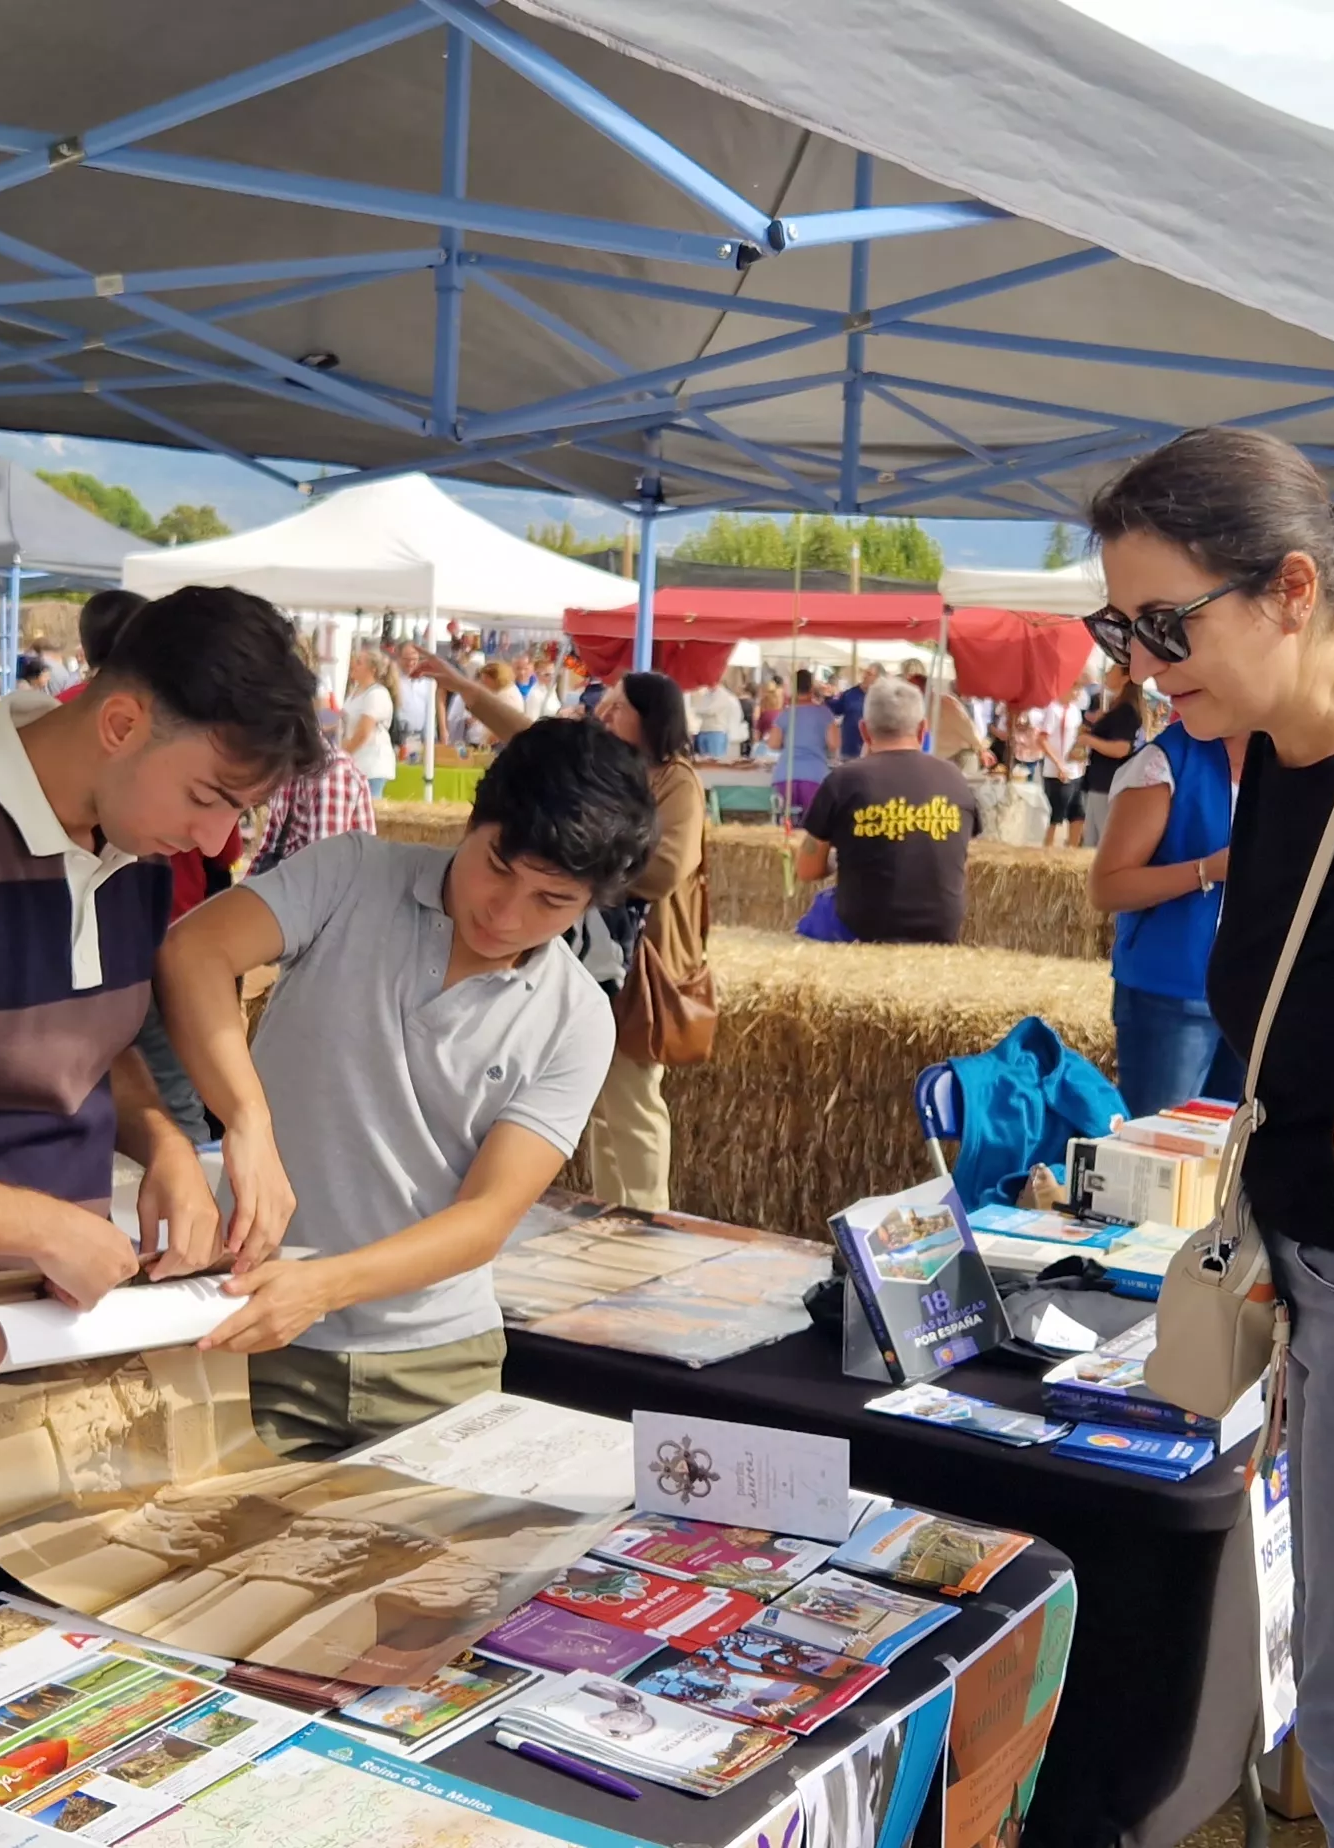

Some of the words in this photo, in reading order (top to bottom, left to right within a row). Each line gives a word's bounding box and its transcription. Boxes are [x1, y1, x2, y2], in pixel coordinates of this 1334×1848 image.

[921, 1290, 950, 1315] 18
[903, 1319, 936, 1340] RUTAS
[915, 1332, 938, 1348] POR
[938, 1314, 984, 1338] ESPAÑA
[1261, 1539, 1274, 1574] 18
[359, 1760, 400, 1780] Reino
[402, 1776, 421, 1788] de
[423, 1781, 443, 1795] los
[446, 1790, 494, 1813] Mallos
